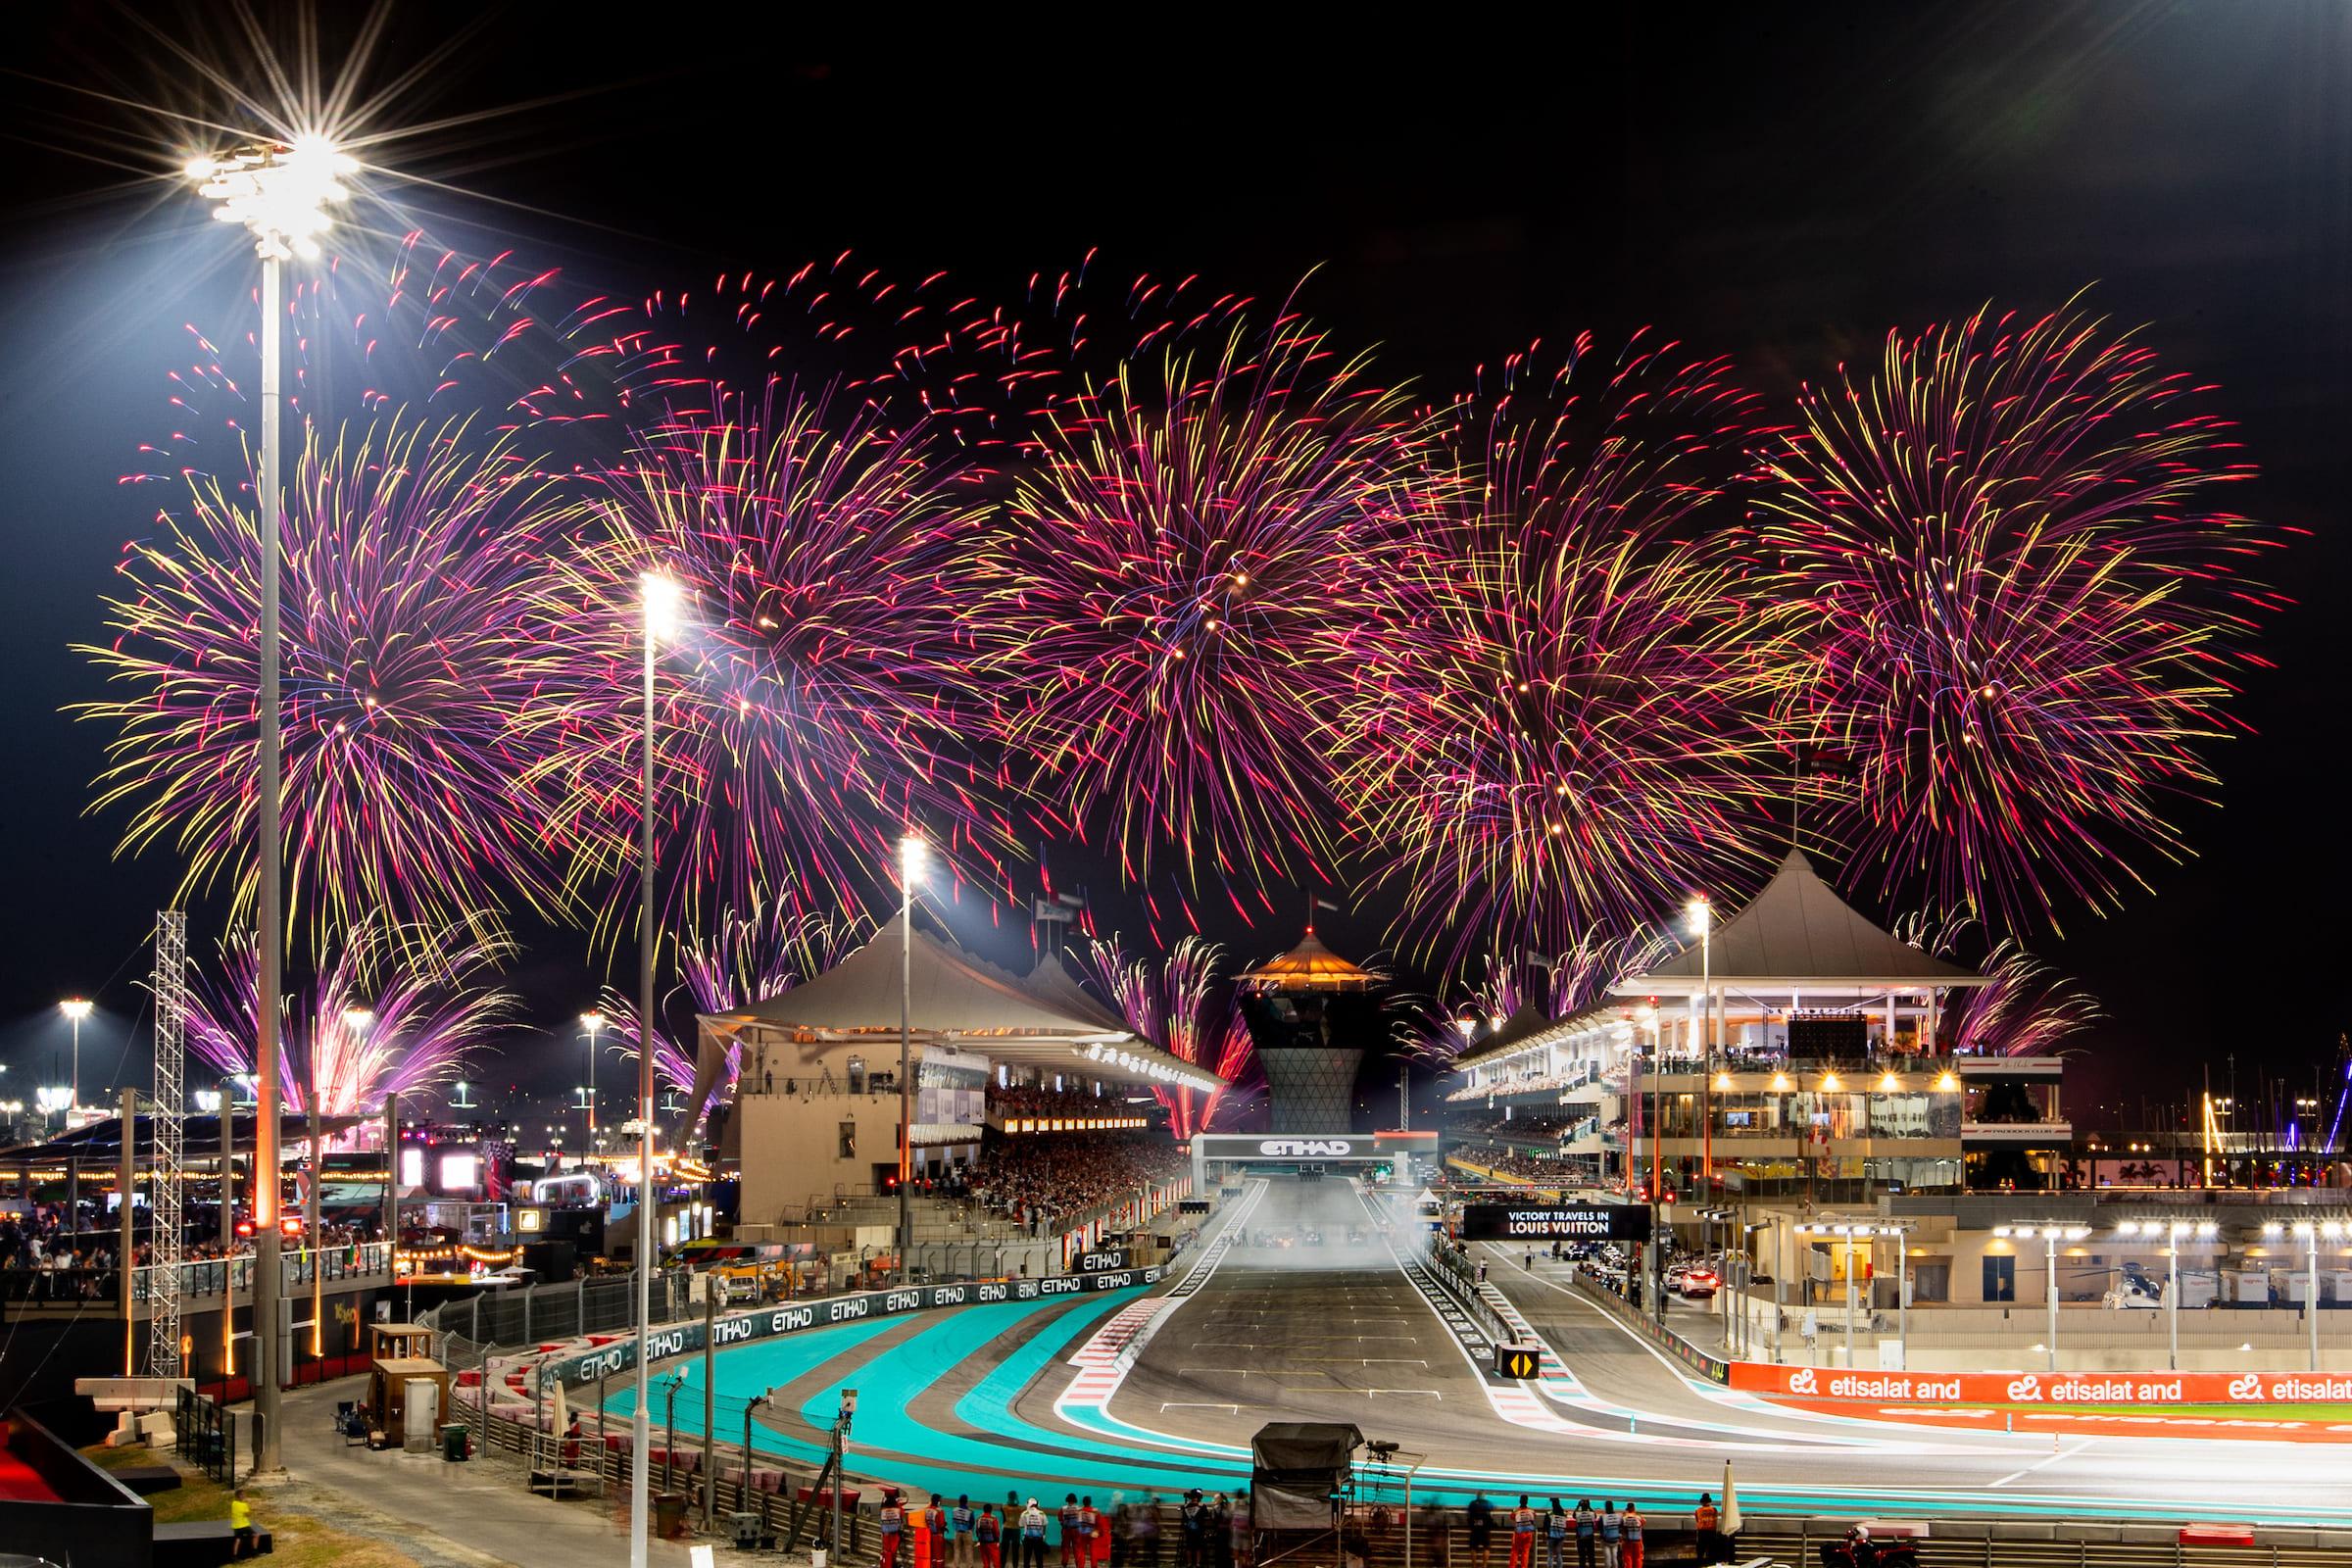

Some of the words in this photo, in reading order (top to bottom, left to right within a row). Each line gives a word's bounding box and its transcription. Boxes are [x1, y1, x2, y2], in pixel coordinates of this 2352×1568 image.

[1260, 1141, 1350, 1155] ETIHAD
[1508, 1211, 1550, 1221] VICTORY
[1553, 1211, 1594, 1221] TRAVELS
[1597, 1211, 1609, 1221] IN
[1509, 1222, 1548, 1234] LOUIS
[1551, 1222, 1609, 1234] VUITTON
[1083, 1252, 1121, 1270] ETIHAD
[1041, 1280, 1080, 1293] ETIHAD
[1098, 1273, 1131, 1289] ETIHAD
[886, 1291, 919, 1311] ETIHAD
[935, 1287, 964, 1304] ETIHAD
[979, 1285, 1006, 1300] ETIHAD
[831, 1298, 867, 1320] ETIHAD
[772, 1308, 812, 1332] ETIHAD
[713, 1319, 752, 1343] TIHAD
[1830, 1376, 1911, 1399] etisalat
[1916, 1379, 1960, 1399] and
[2051, 1380, 2133, 1401] etisalat
[2138, 1380, 2181, 1401] and
[2272, 1379, 2352, 1400] etisalat
